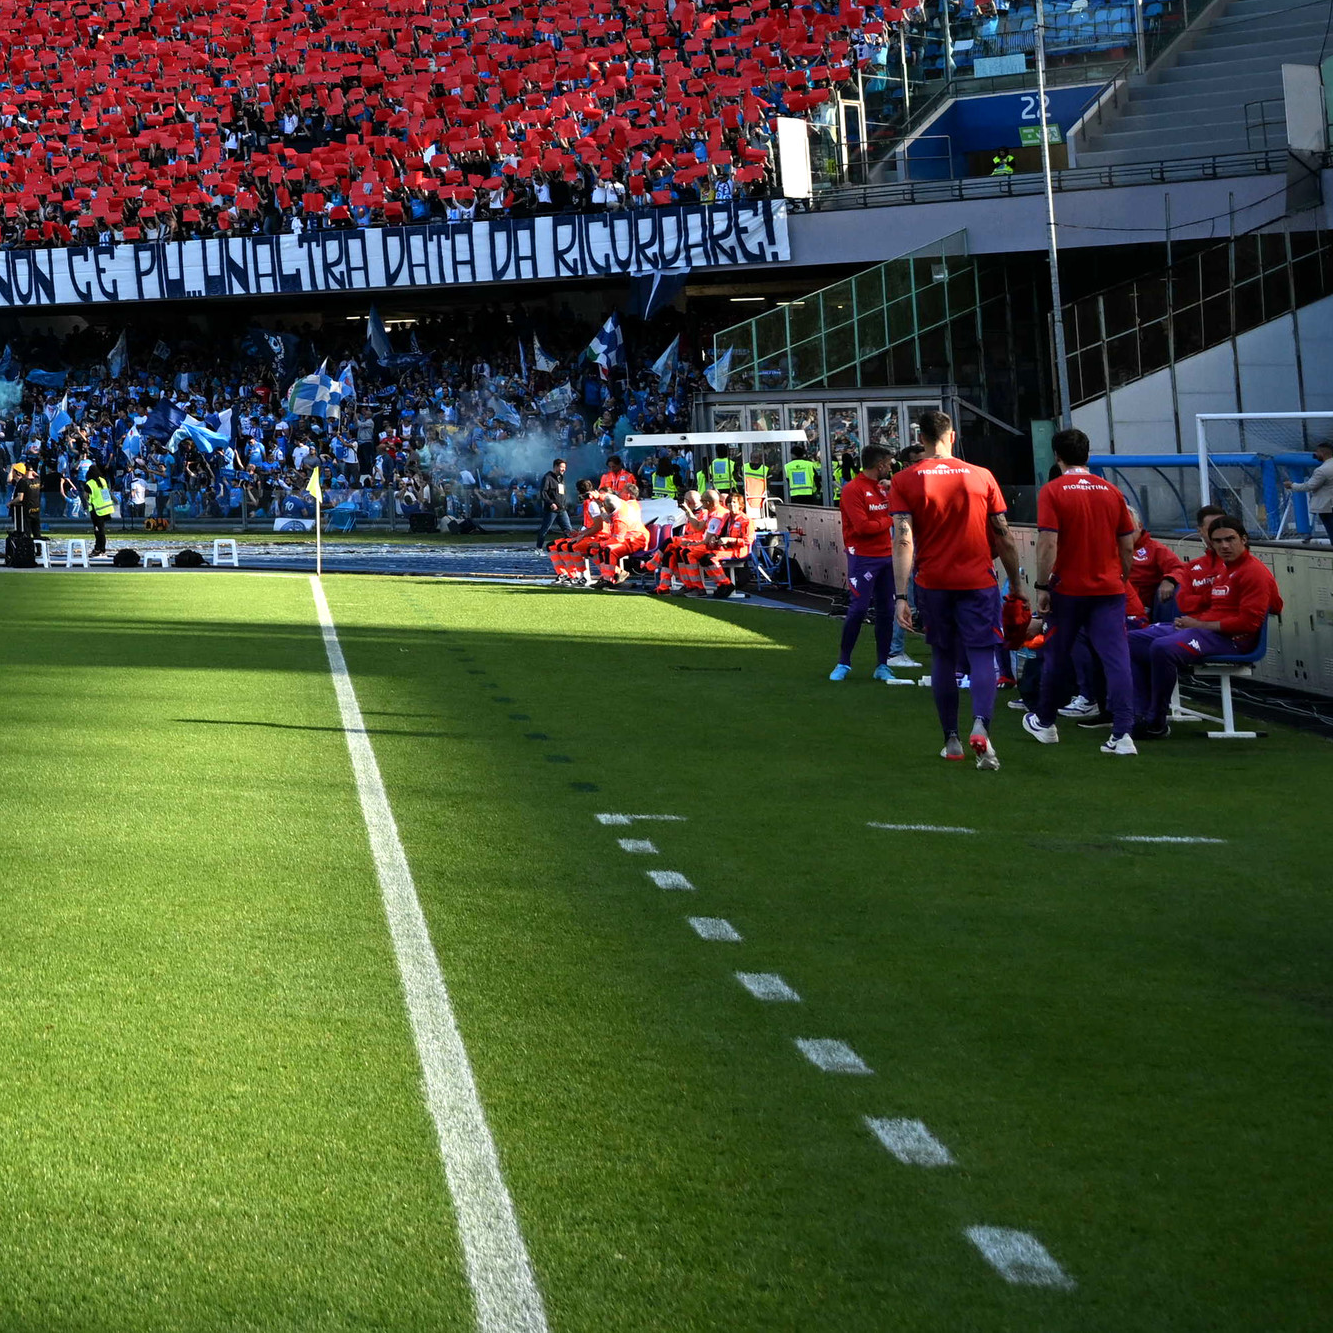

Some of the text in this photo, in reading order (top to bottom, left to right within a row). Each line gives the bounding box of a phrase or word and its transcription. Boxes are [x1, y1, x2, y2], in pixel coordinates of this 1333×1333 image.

[383, 222, 478, 288] DATA
[488, 217, 537, 281] DA
[917, 468, 970, 476] FIORENTINA
